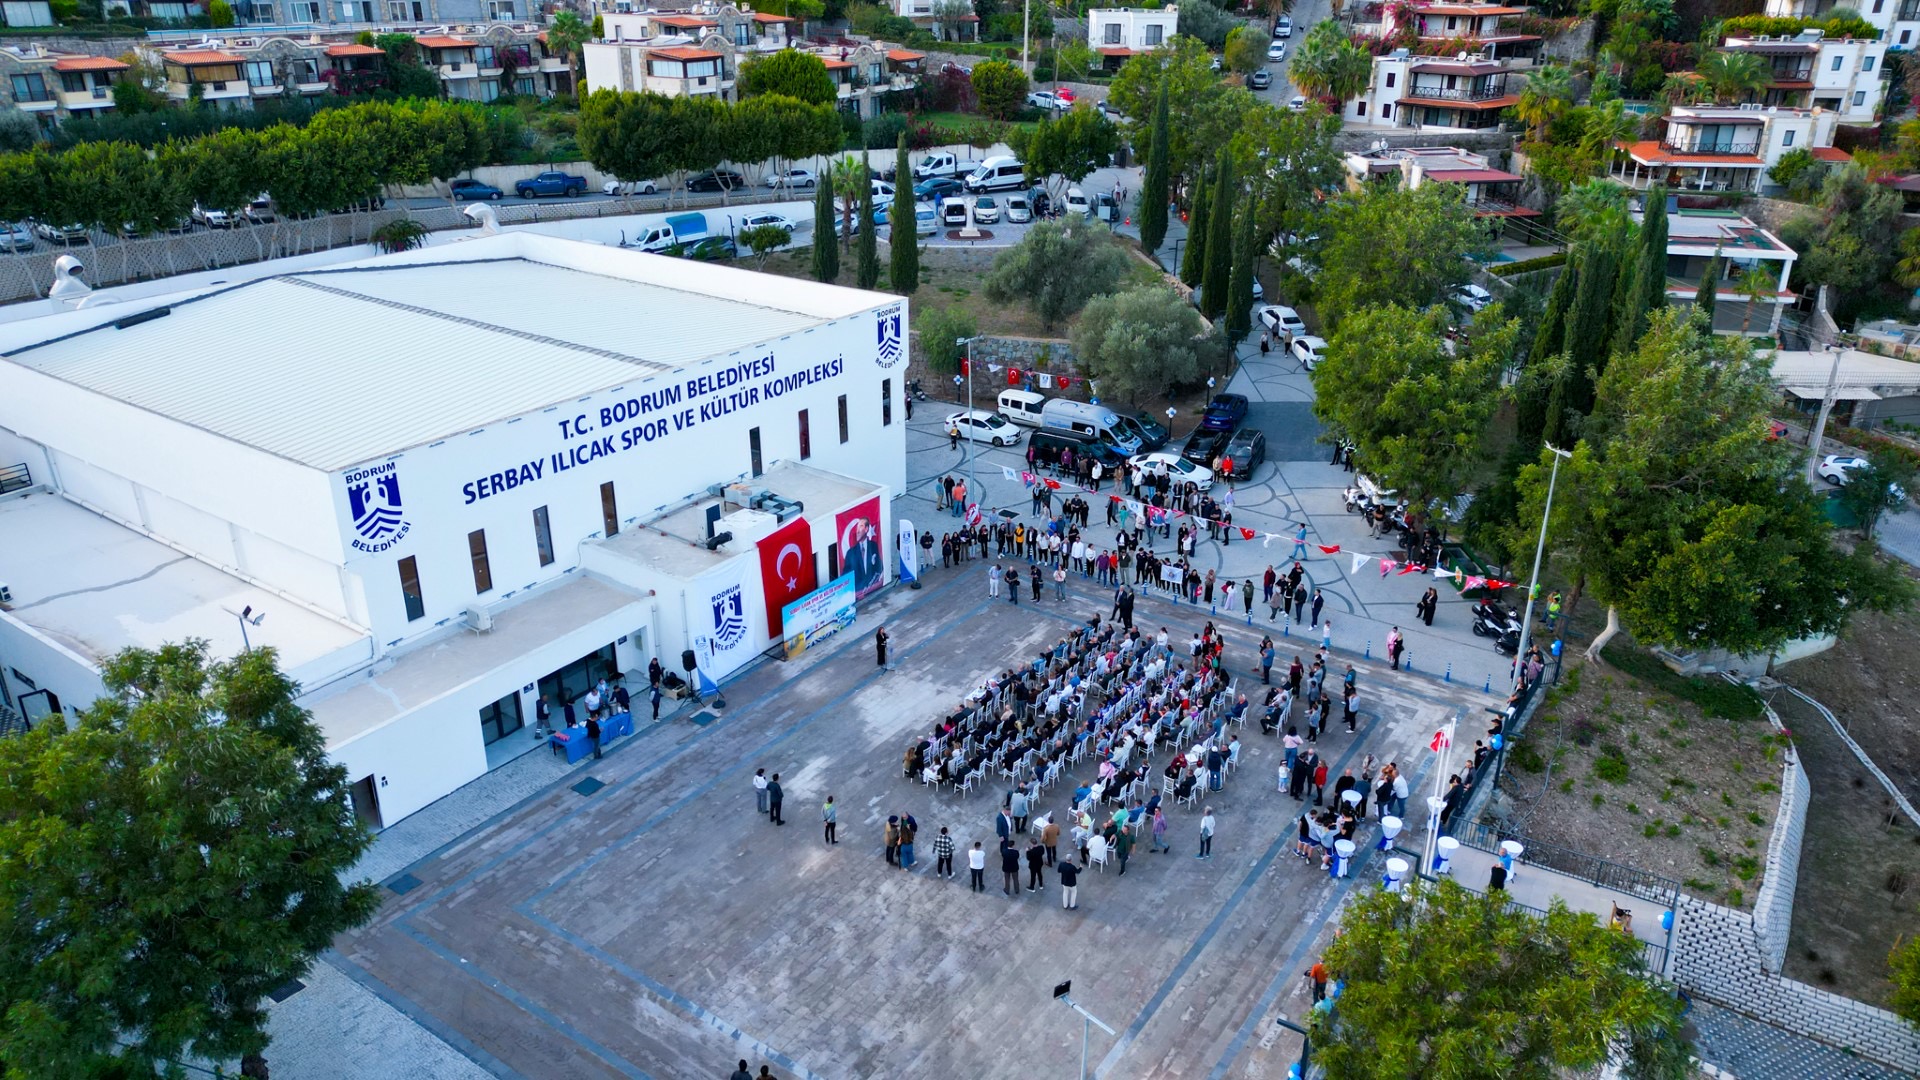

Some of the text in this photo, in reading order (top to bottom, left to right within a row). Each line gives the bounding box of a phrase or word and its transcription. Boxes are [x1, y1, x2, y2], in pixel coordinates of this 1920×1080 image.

[877, 306, 901, 319] BODRUM
[558, 351, 775, 440] T.C. BODRUM BELEDİYESİ
[462, 353, 843, 505] SERBAY ILICAK SPOR VE KÜLTÜR KOMPLEKSİ
[345, 461, 396, 484] BODRUM
[711, 583, 741, 603] BODRUM
